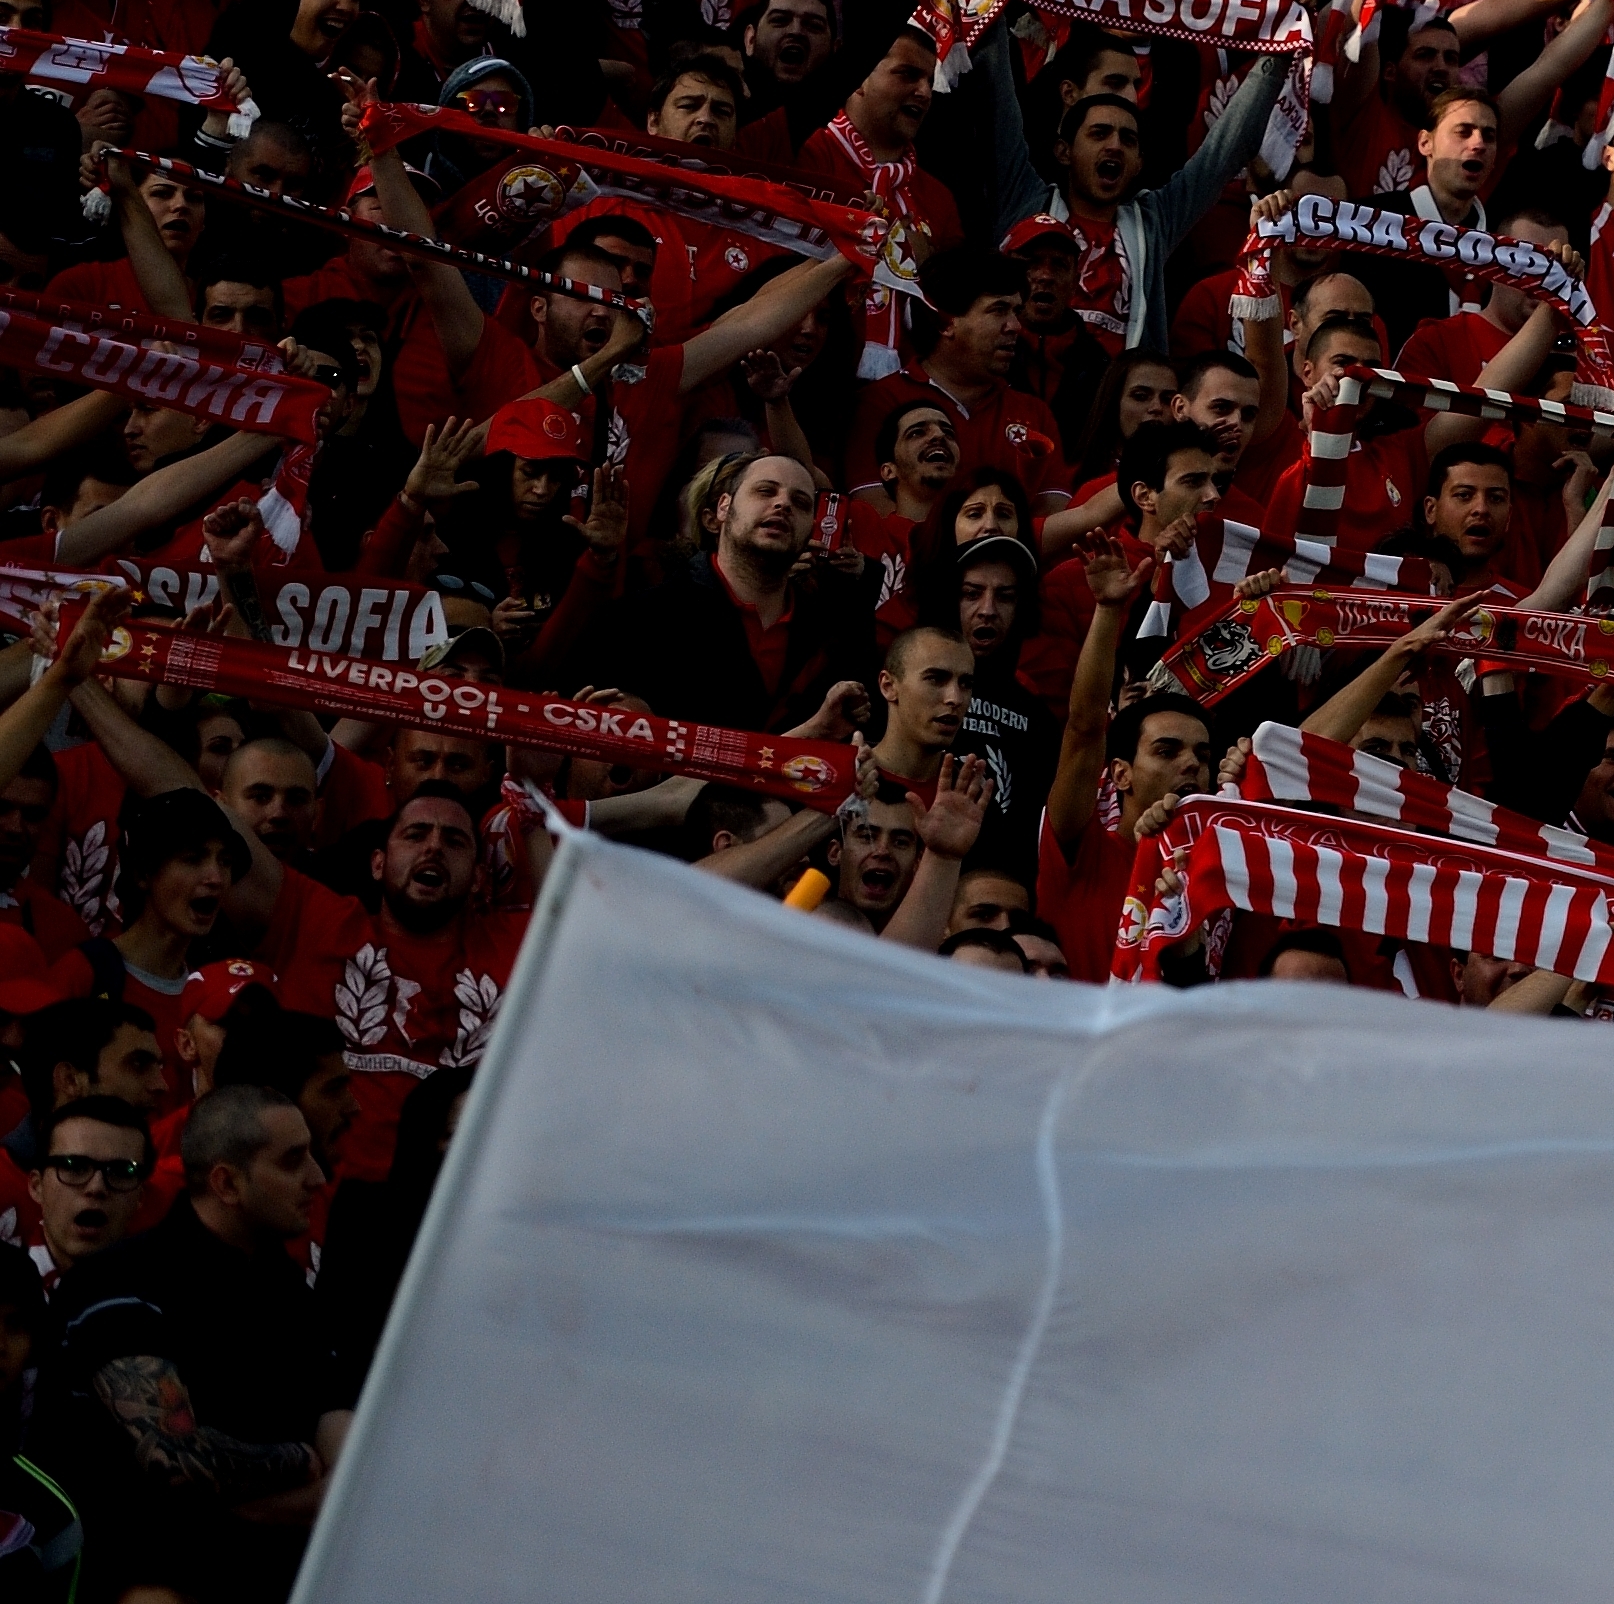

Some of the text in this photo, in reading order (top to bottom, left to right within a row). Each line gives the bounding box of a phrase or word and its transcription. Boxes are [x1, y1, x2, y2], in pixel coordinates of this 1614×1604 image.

[1256, 193, 1599, 328] ЦСКА СОФИ
[34, 325, 289, 424] СОФИЯ
[122, 558, 450, 662] CSK SOFIA
[1335, 597, 1588, 661] ULTRA CSKA
[287, 648, 504, 714] LIVERPOOL
[542, 701, 656, 742] CSKA
[971, 696, 1030, 732] MODERN
